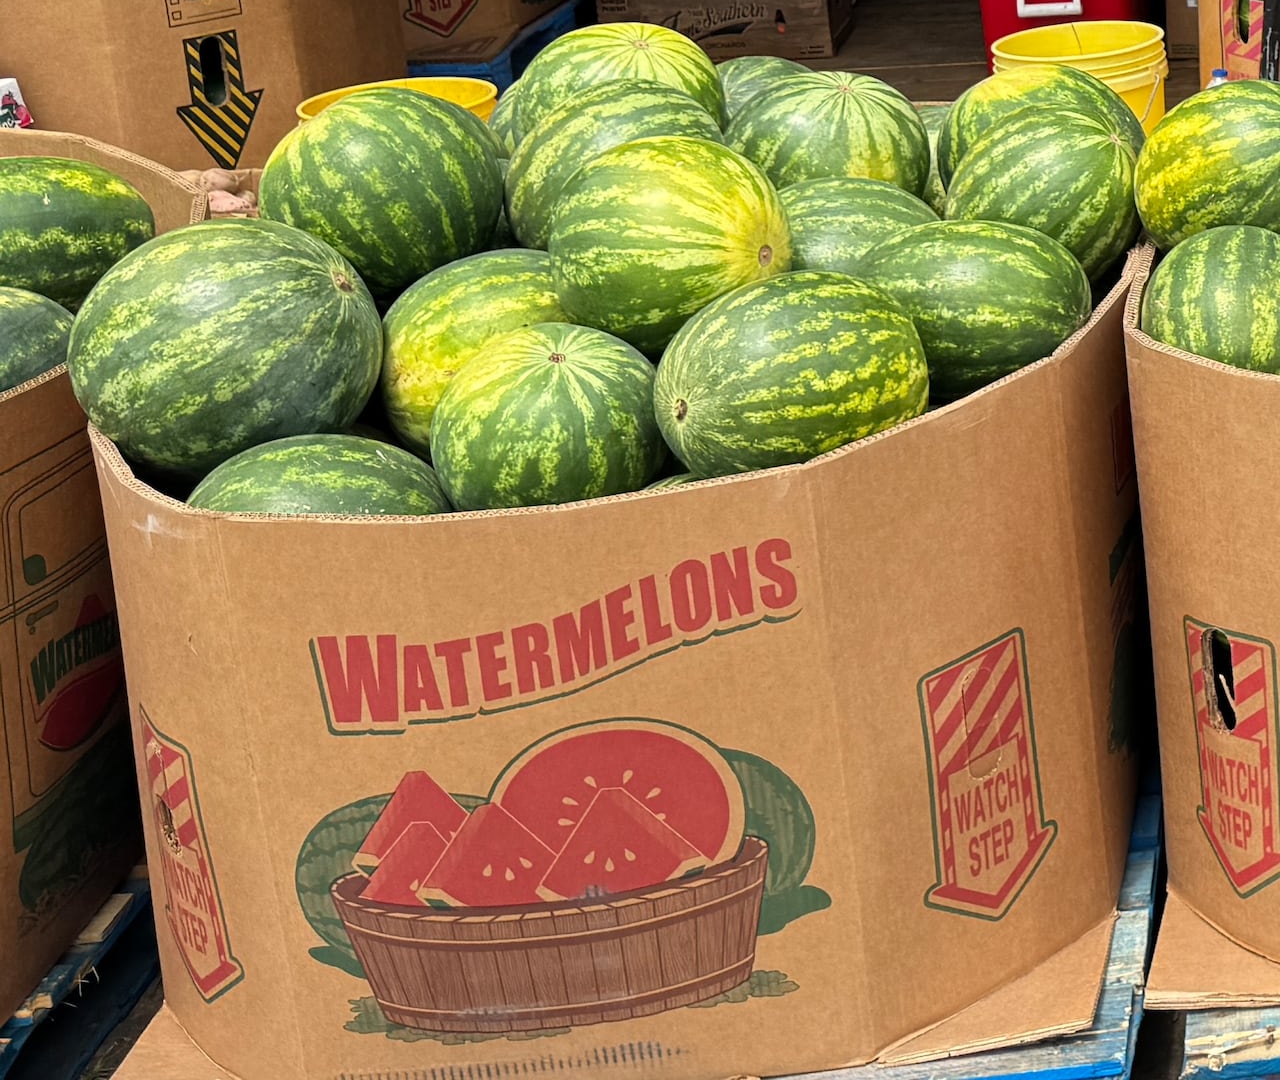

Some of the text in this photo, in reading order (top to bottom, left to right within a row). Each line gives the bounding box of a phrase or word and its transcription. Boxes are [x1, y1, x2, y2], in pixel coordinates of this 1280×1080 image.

[703, 1, 767, 29] Southern
[317, 538, 798, 724] WATERMELONS
[954, 764, 1020, 835] WATCH
[1207, 746, 1260, 807] WATCH
[969, 818, 1014, 877] STEP
[1218, 798, 1252, 851] STEP
[178, 902, 208, 956] STEP
